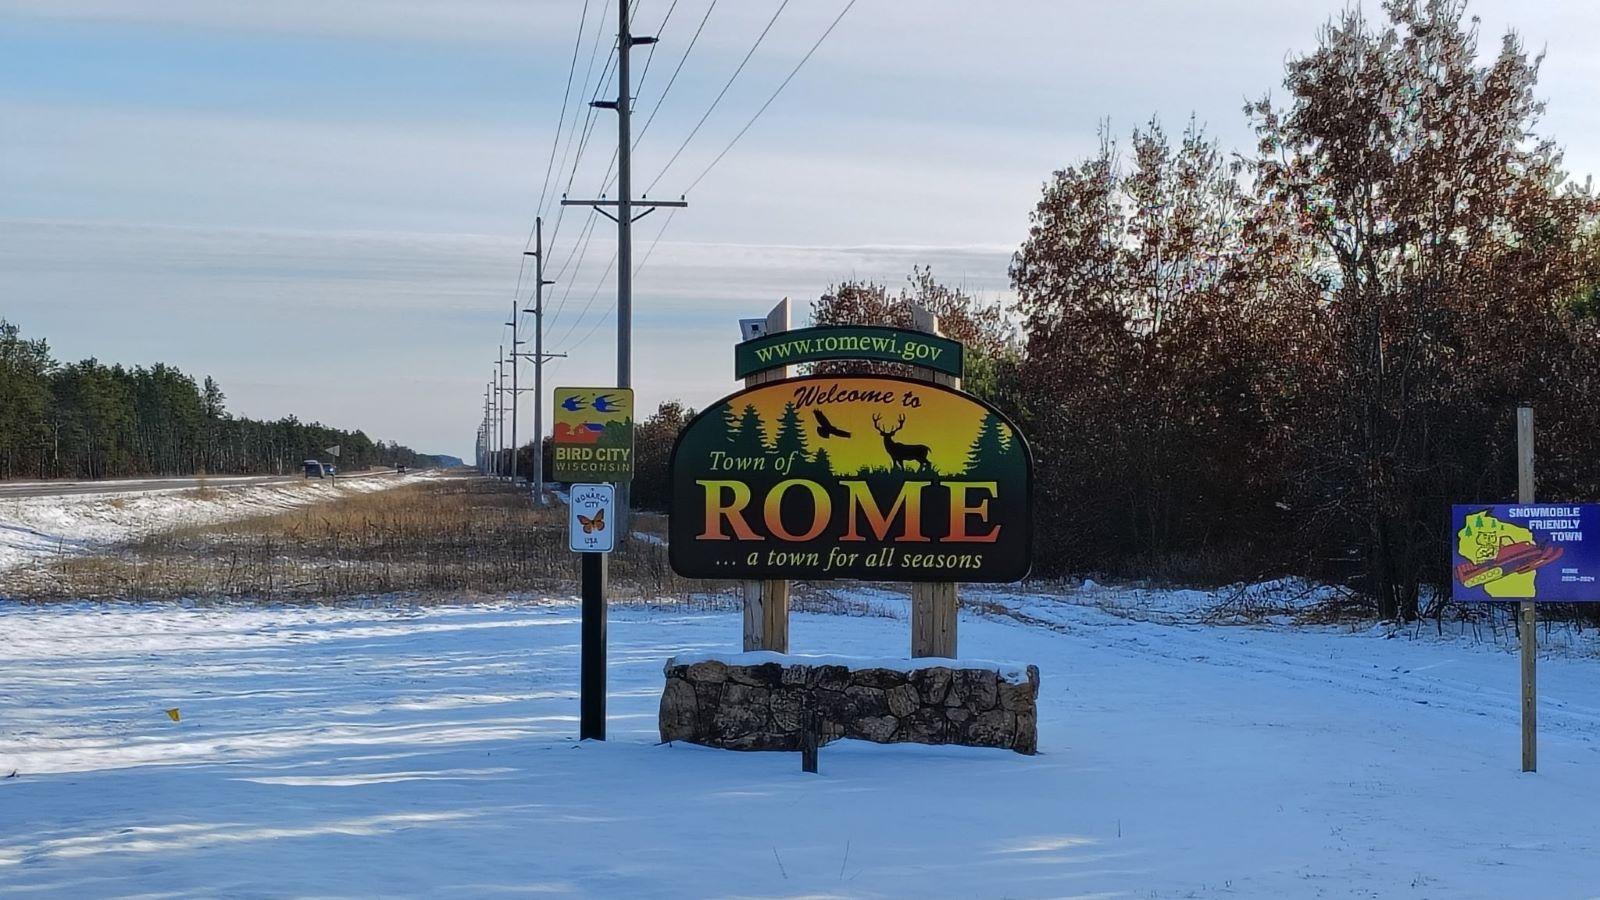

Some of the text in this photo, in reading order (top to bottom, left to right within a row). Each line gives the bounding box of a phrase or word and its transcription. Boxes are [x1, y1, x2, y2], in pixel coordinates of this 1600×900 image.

[756, 333, 943, 362] www.romewi.gov
[793, 384, 922, 409] Welcome to
[556, 448, 630, 461] BIRD CITY
[556, 462, 630, 472] WISCONSIN
[709, 451, 797, 475] Town of
[575, 493, 608, 504] MONARCH
[695, 478, 1001, 542] ROME
[1509, 507, 1580, 517] SNOWMOBILE
[1529, 520, 1580, 530] FRIENDLY
[1550, 532, 1582, 541] TOWN
[747, 549, 759, 566] a
[767, 549, 819, 567] town
[823, 547, 858, 571] for
[865, 548, 894, 568] all
[901, 553, 983, 569] seasons
